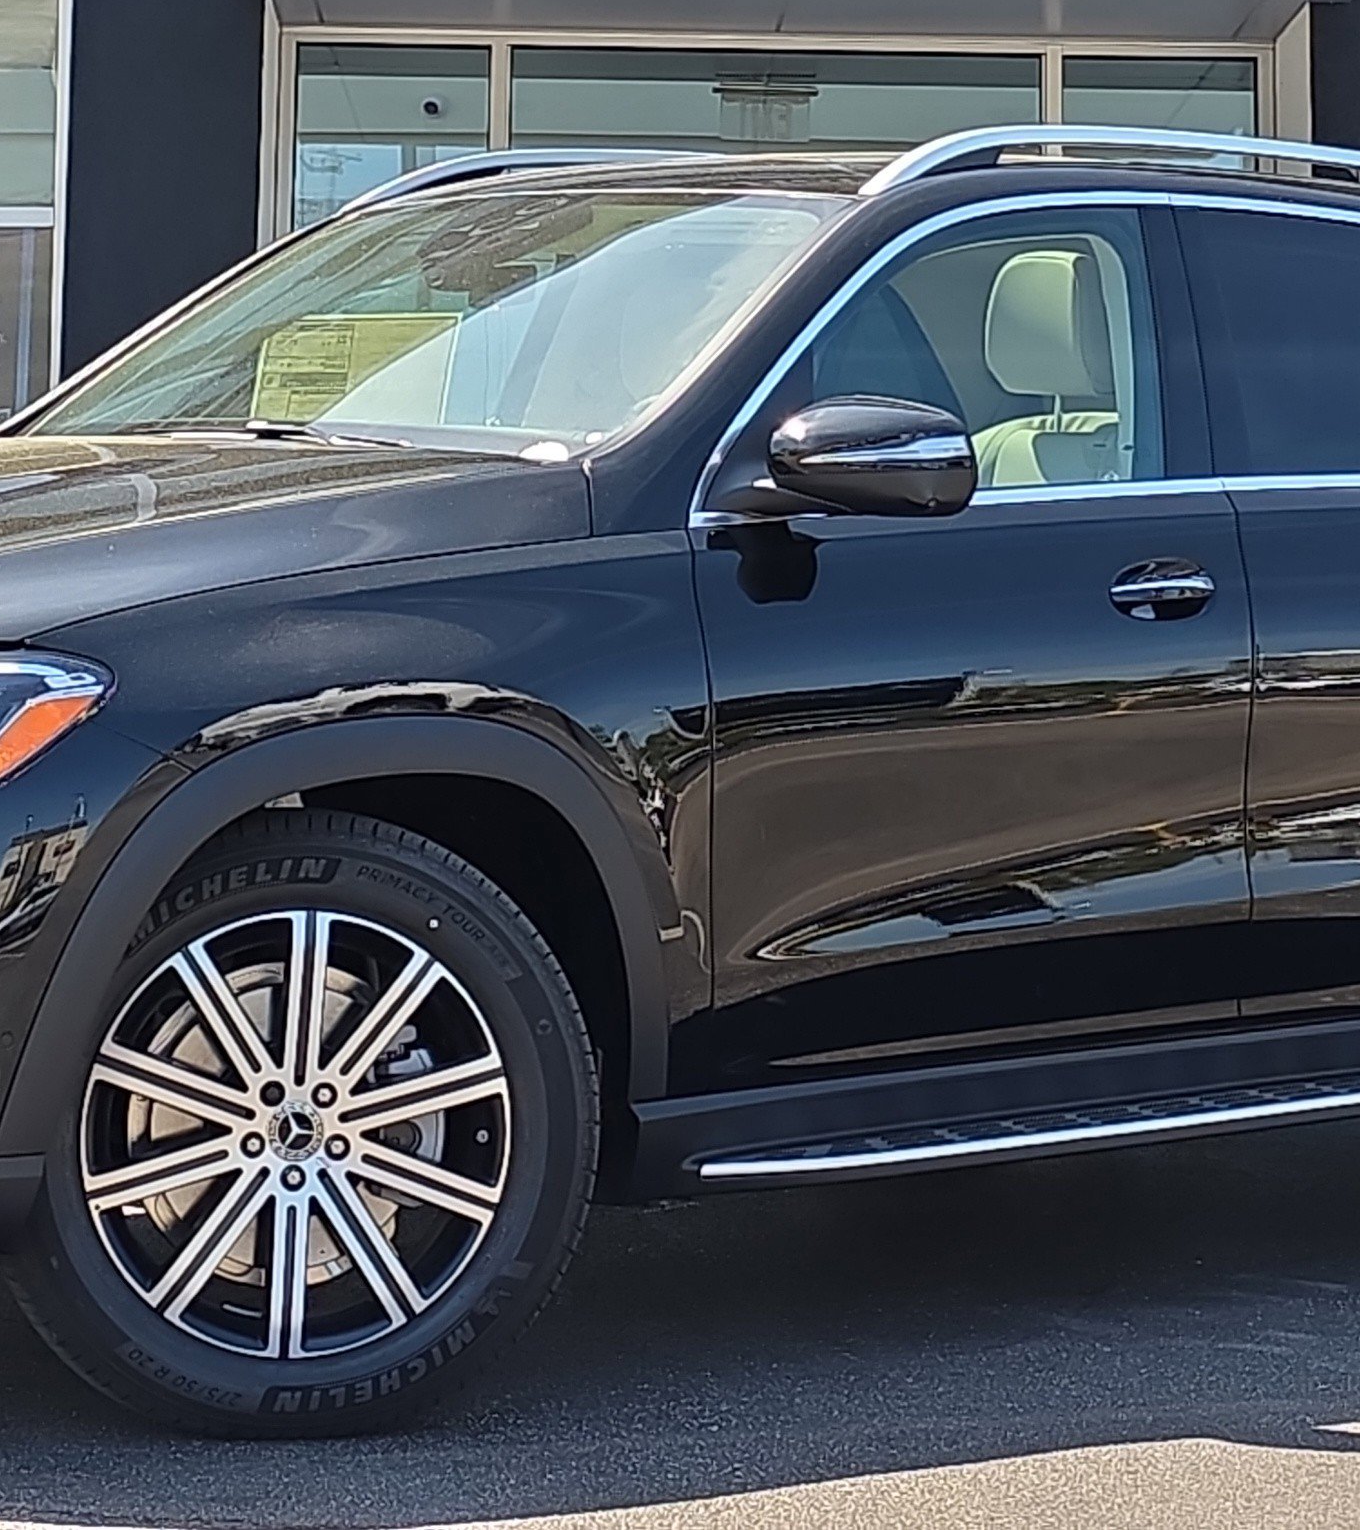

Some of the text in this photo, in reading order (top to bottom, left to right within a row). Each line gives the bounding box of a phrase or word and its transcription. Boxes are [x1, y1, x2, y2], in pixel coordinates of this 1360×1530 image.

[357, 865, 438, 903] PRIMACY
[442, 903, 485, 941] TOUR
[272, 1321, 476, 1413] MICHELIN
